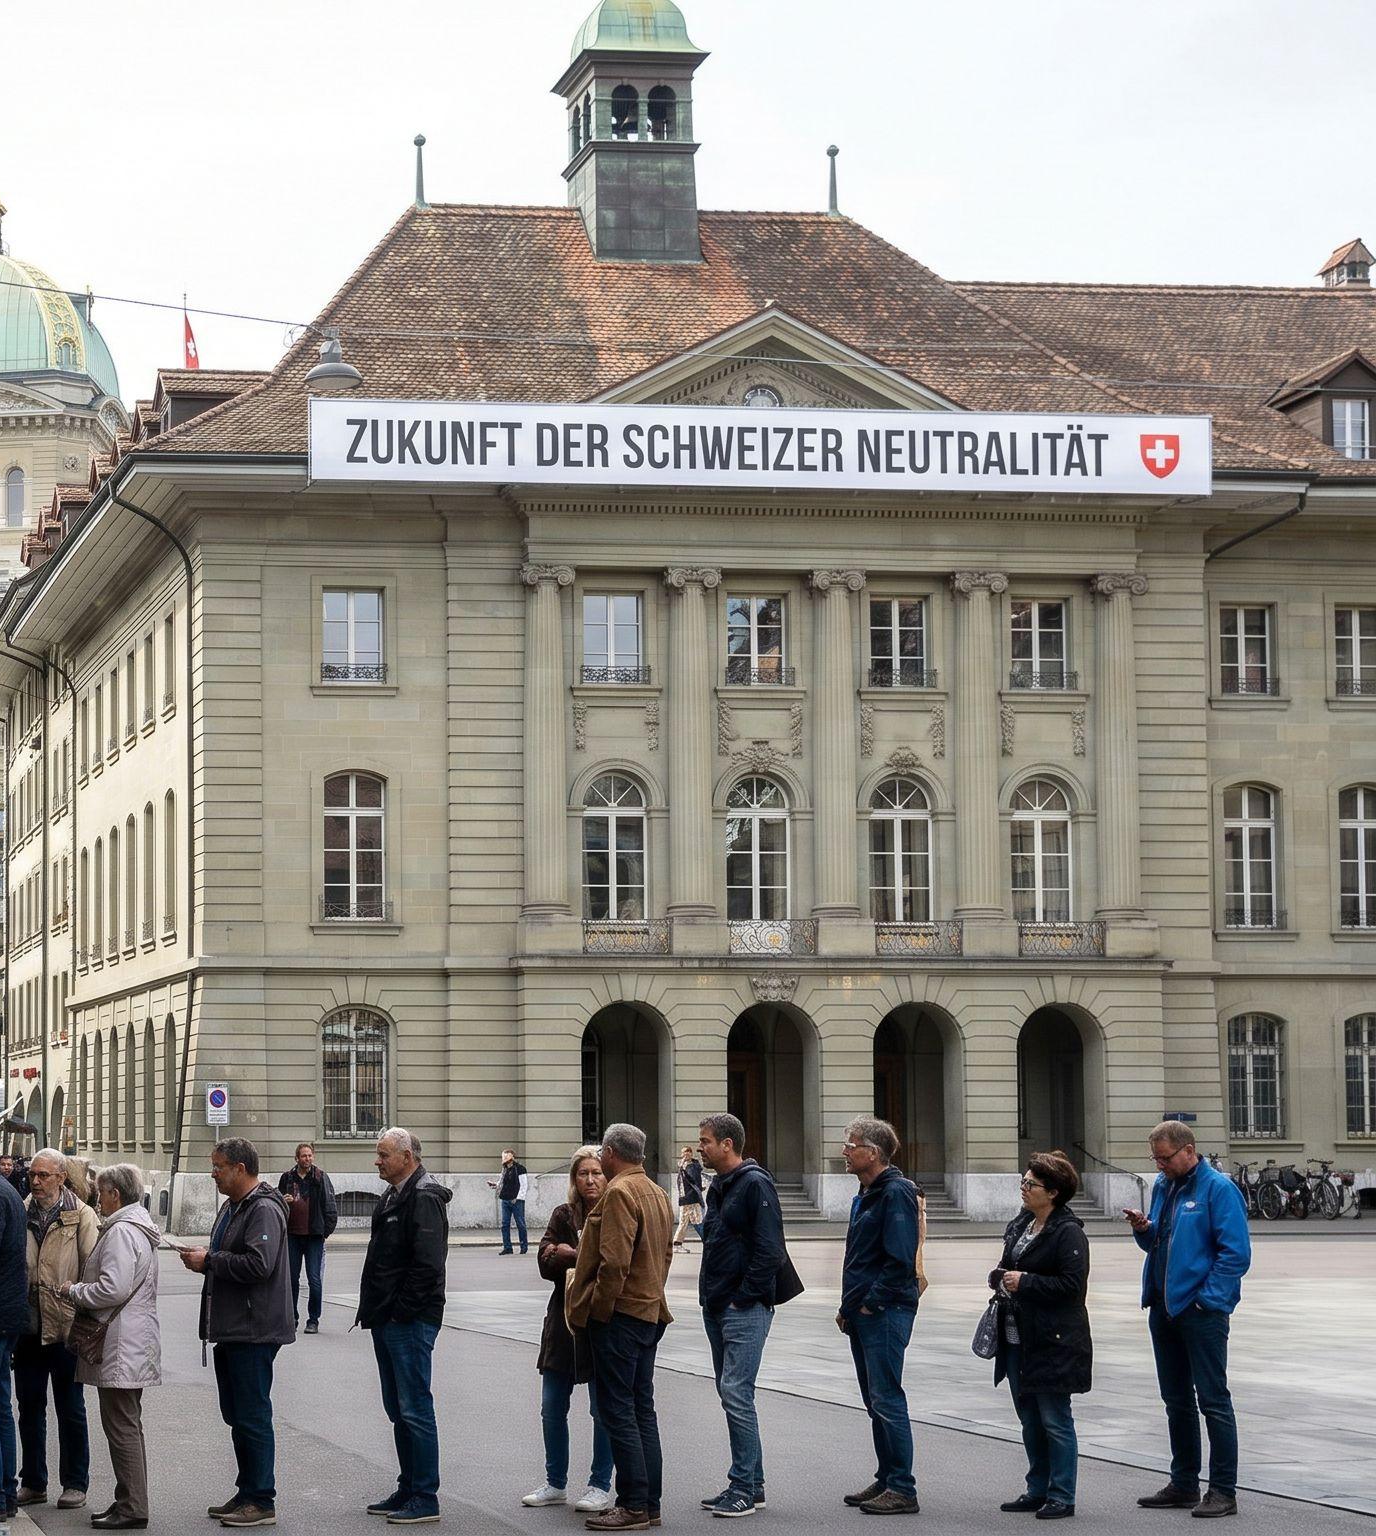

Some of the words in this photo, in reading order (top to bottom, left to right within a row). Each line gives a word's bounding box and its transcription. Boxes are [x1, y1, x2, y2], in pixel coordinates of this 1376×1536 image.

[346, 418, 522, 467] ZUKUNFT
[536, 422, 609, 468] DER
[622, 423, 844, 473] SCHWEIZER
[857, 424, 1109, 477] NEUTRALITÄT
